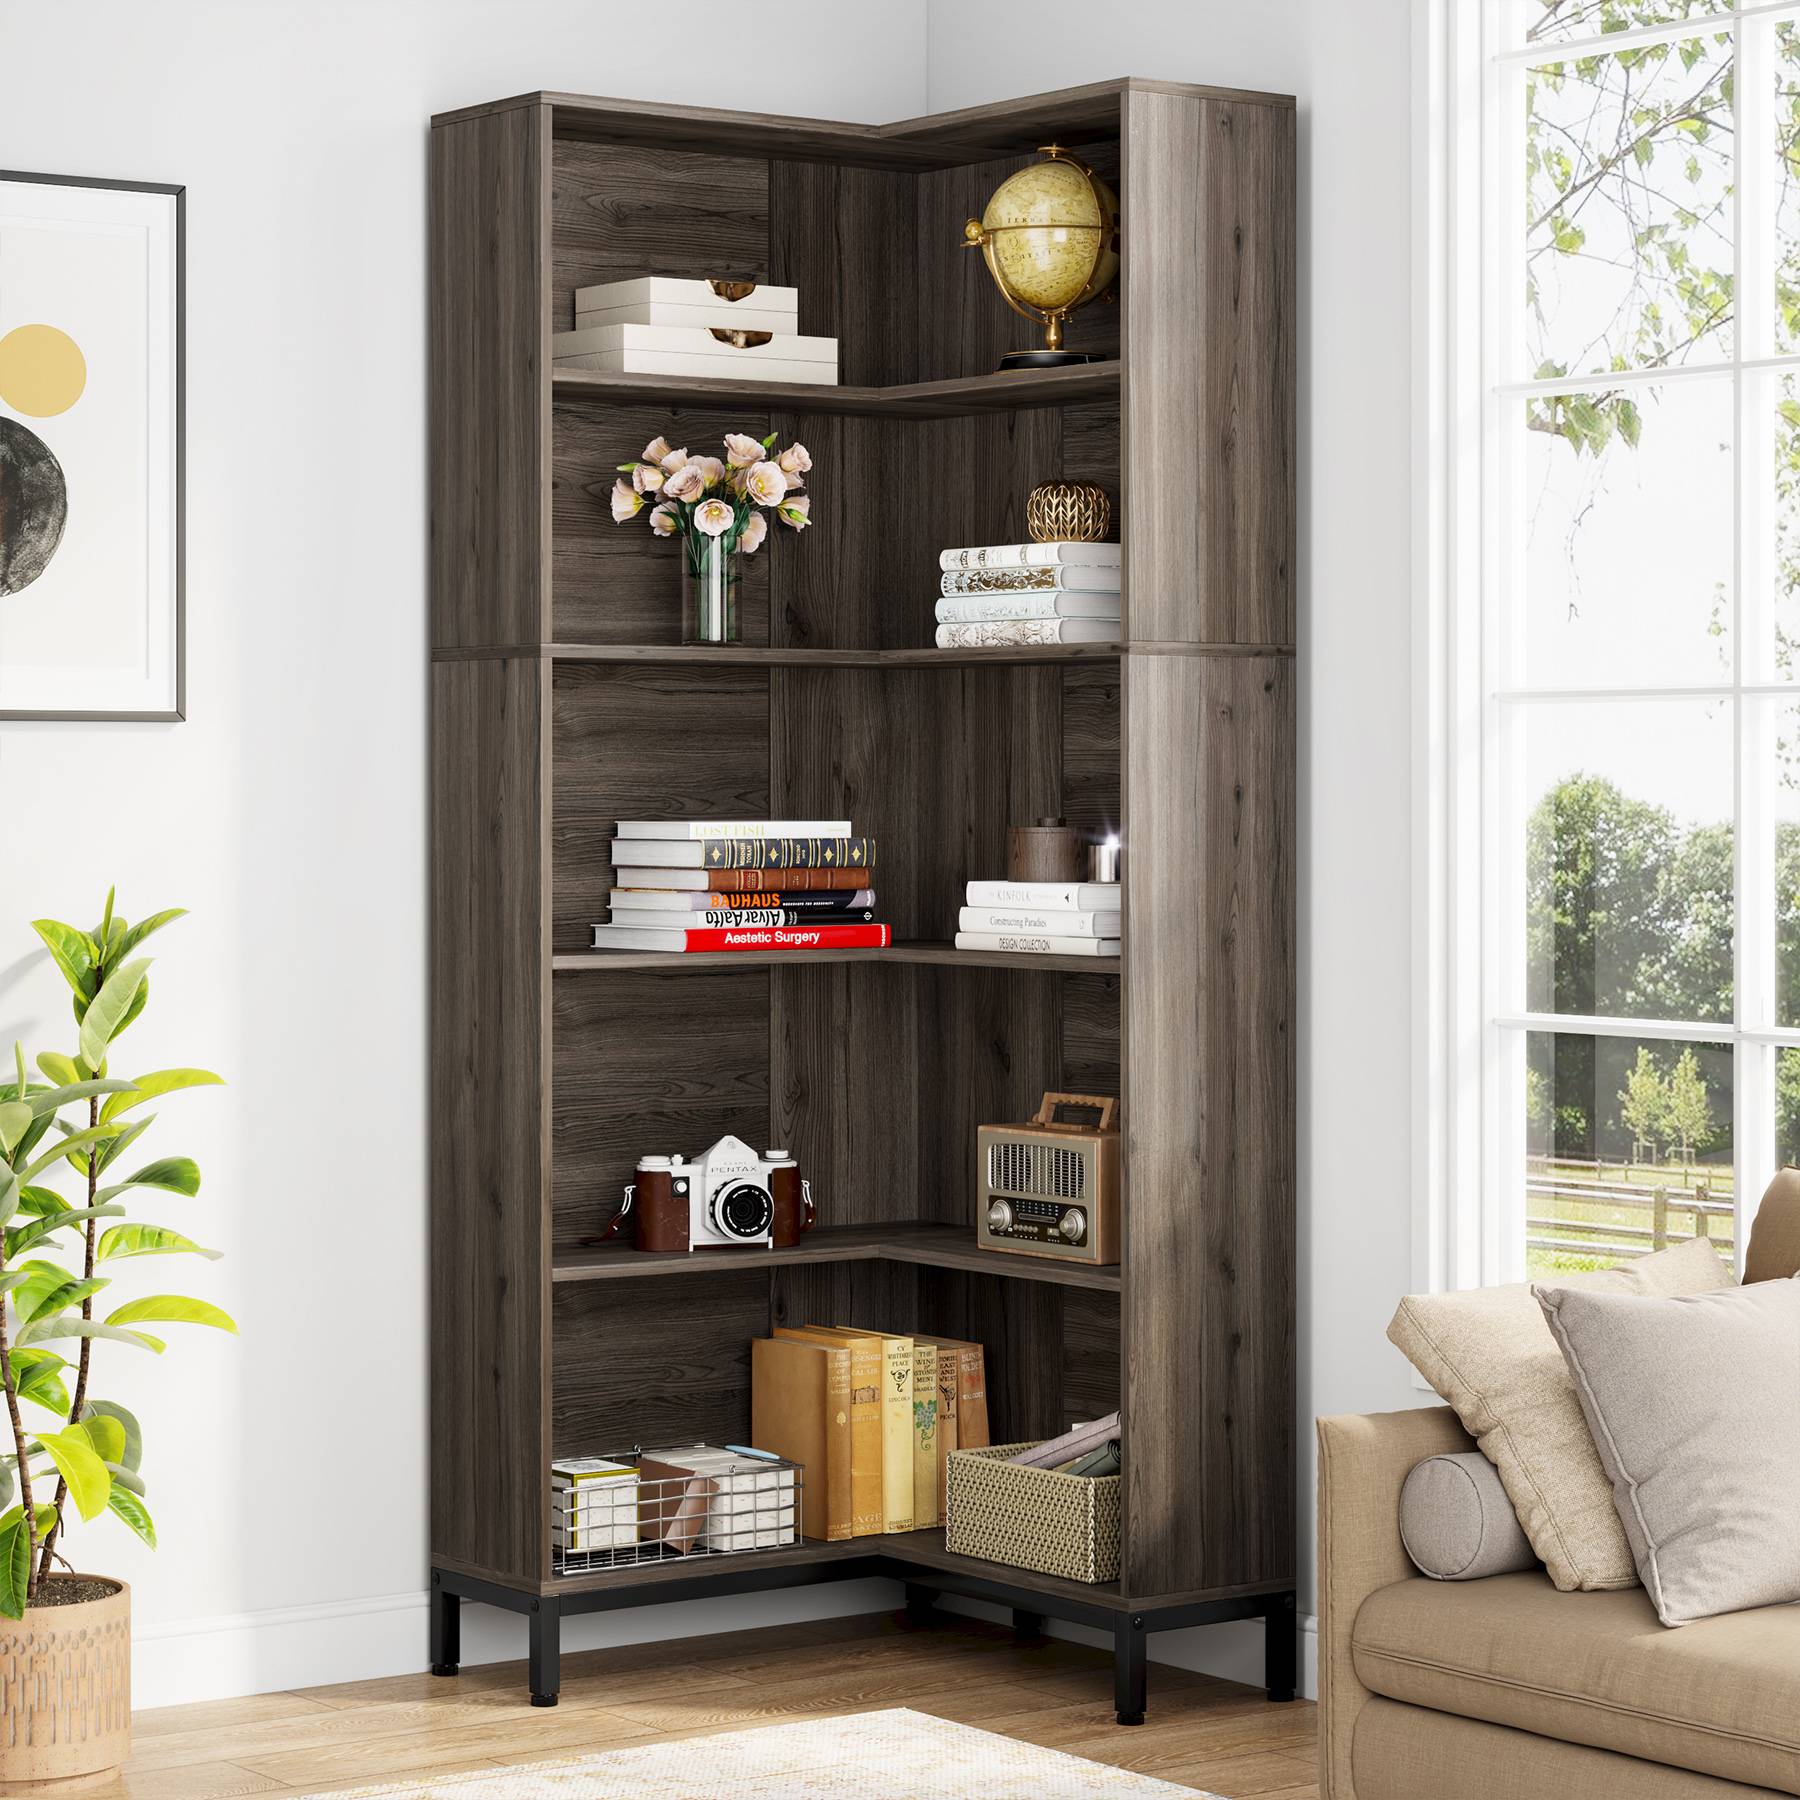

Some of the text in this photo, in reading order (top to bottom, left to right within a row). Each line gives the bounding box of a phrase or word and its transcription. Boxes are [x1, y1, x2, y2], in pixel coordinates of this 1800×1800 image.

[693, 824, 765, 837] LOST FISH
[711, 893, 781, 908] BAUHAUS
[706, 910, 743, 930] Aalto
[745, 909, 780, 927] Alvar
[990, 916, 1023, 929] Constructing
[724, 930, 820, 945] Aestetic Surgery
[999, 937, 1051, 952] DESIGN COLLECTION
[711, 1165, 758, 1174] PENTAX
[940, 1369, 955, 1377] AND
